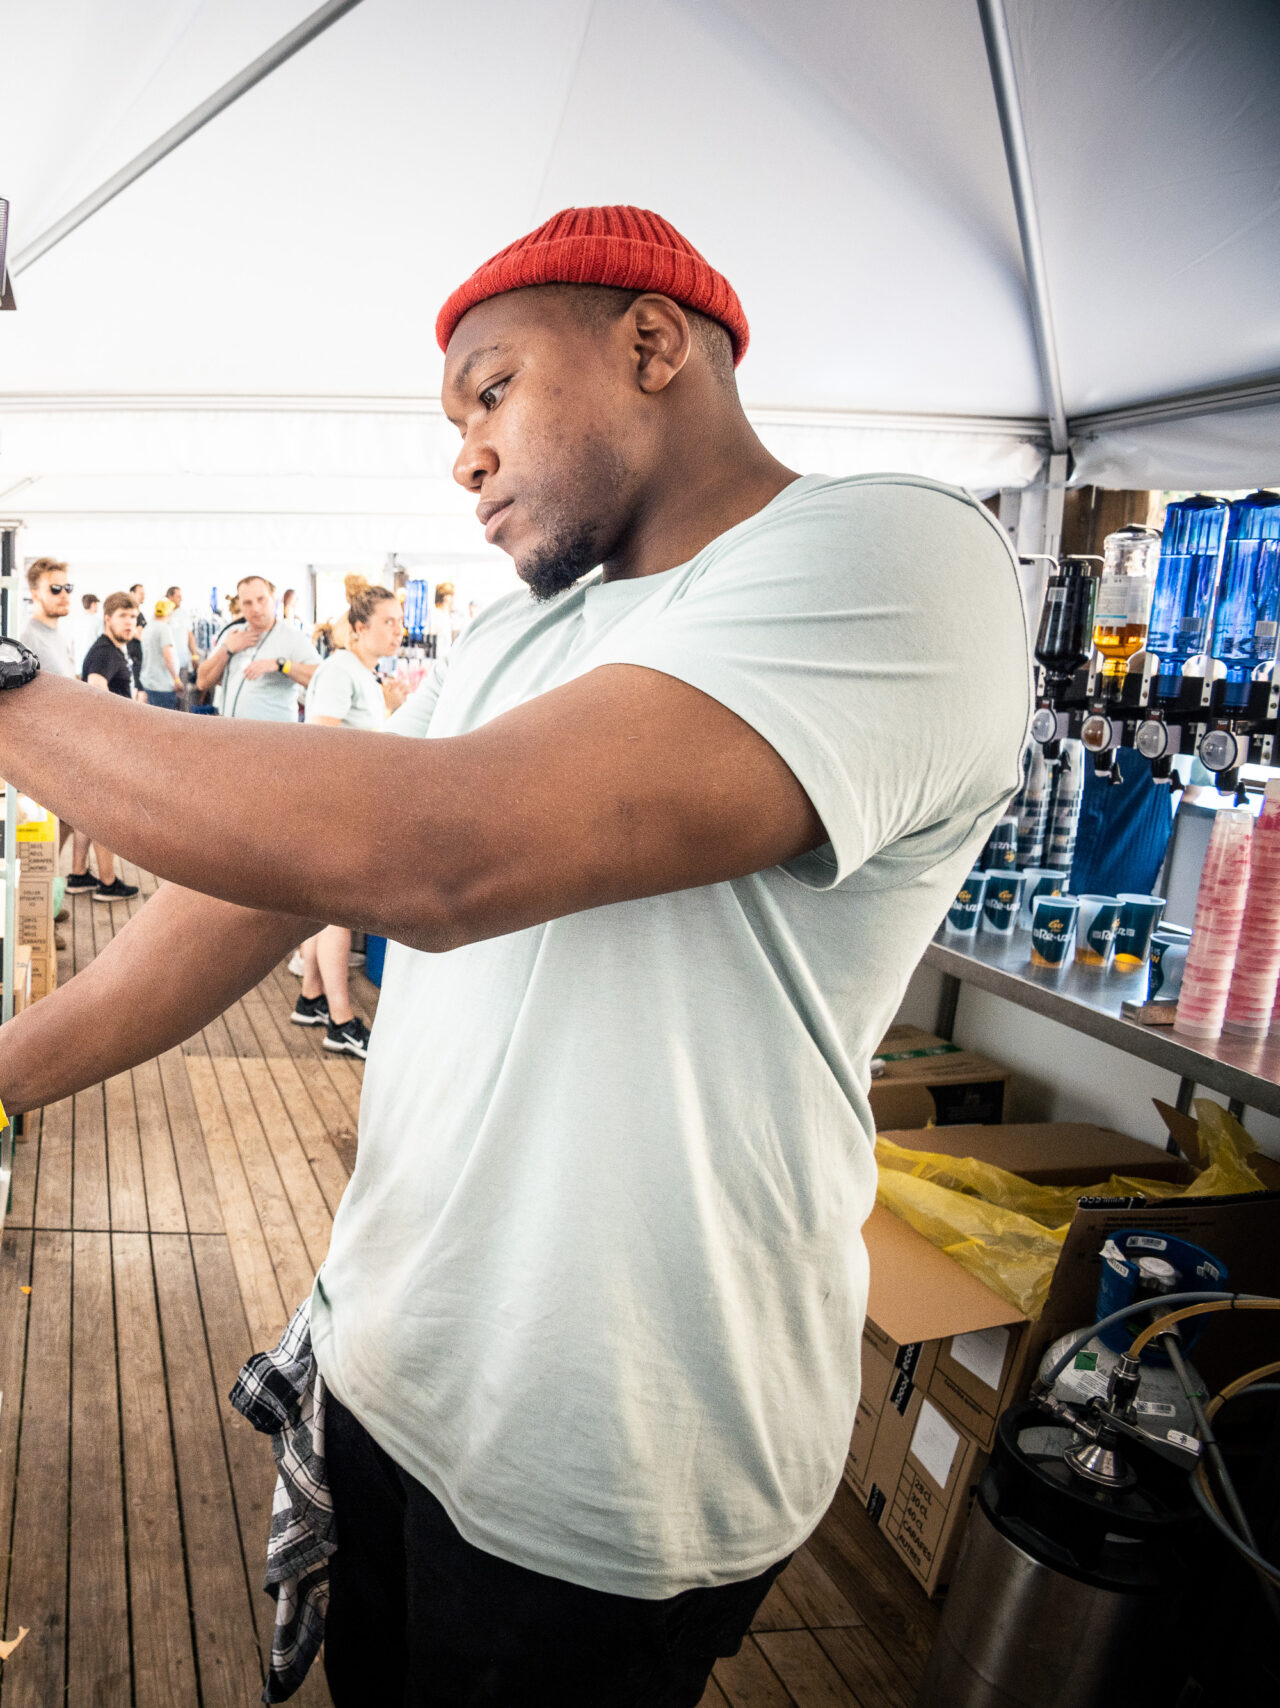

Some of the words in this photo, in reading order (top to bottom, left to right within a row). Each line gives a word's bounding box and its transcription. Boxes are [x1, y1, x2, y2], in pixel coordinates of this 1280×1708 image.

[920, 1505, 928, 1520] CL
[915, 1520, 924, 1534] CL
[903, 1521, 932, 1562] CARAFES
